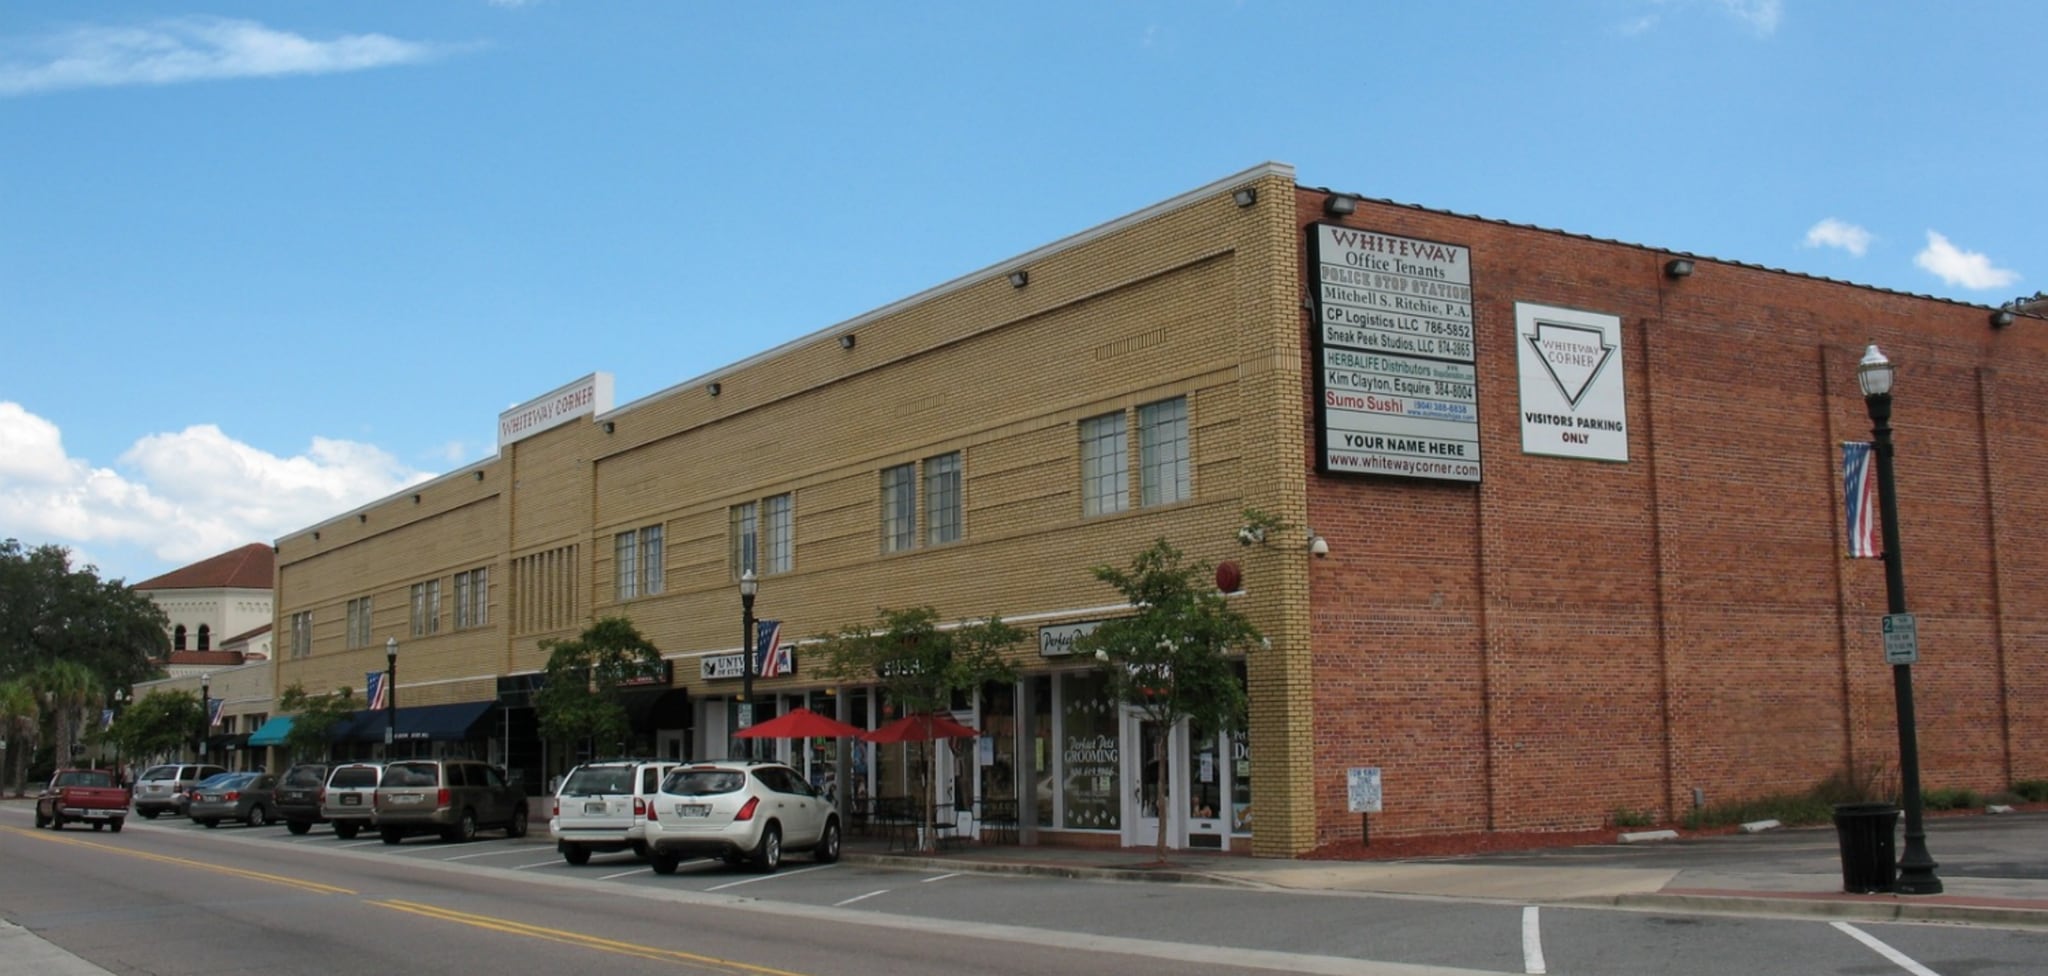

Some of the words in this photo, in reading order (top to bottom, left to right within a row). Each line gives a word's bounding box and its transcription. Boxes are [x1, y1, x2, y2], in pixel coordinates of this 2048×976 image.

[1331, 229, 1457, 264] WHITEWAY
[1345, 251, 1390, 272] Office
[1393, 257, 1446, 279] Tenants
[1322, 265, 1371, 287] POLICE
[1374, 273, 1409, 292] STOP
[1411, 279, 1470, 301] STATION
[1324, 286, 1377, 307] Mitchell
[1379, 294, 1392, 307] S.
[1395, 296, 1443, 316] Ritchie,
[1446, 304, 1471, 318] P.A.
[1326, 307, 1343, 321] CP
[1346, 309, 1395, 329] Logistics
[1398, 317, 1419, 332] LLC
[1424, 320, 1471, 338] 786-5852
[1327, 327, 1355, 343] Sneak
[1357, 330, 1378, 346] Peek
[1380, 333, 1416, 352] Studios,
[1418, 338, 1435, 354] LLC
[1542, 339, 1599, 356] WHITEWAY
[1327, 351, 1379, 370] HERBALIFE
[1382, 358, 1431, 376] Distributors
[1547, 351, 1595, 367] CORNER
[1329, 371, 1349, 385] Kim
[1351, 374, 1392, 392] Clayton,
[1394, 382, 1431, 398] Esquire
[502, 402, 554, 436] WHITEWAY
[555, 385, 593, 416] CORNER
[1326, 391, 1365, 408] Sumo
[1367, 395, 1404, 413] Sushi
[1525, 412, 1573, 427] VISITORS
[1577, 417, 1623, 432] PARKING
[1344, 434, 1384, 449] YOUR
[1387, 438, 1426, 453] NAME
[1429, 442, 1464, 456] HERE
[1562, 432, 1589, 444] ONLY
[1330, 453, 1478, 477] www.whitewaycorner.com
[1883, 618, 1891, 631] 2
[1064, 749, 1118, 763] GROOMING
